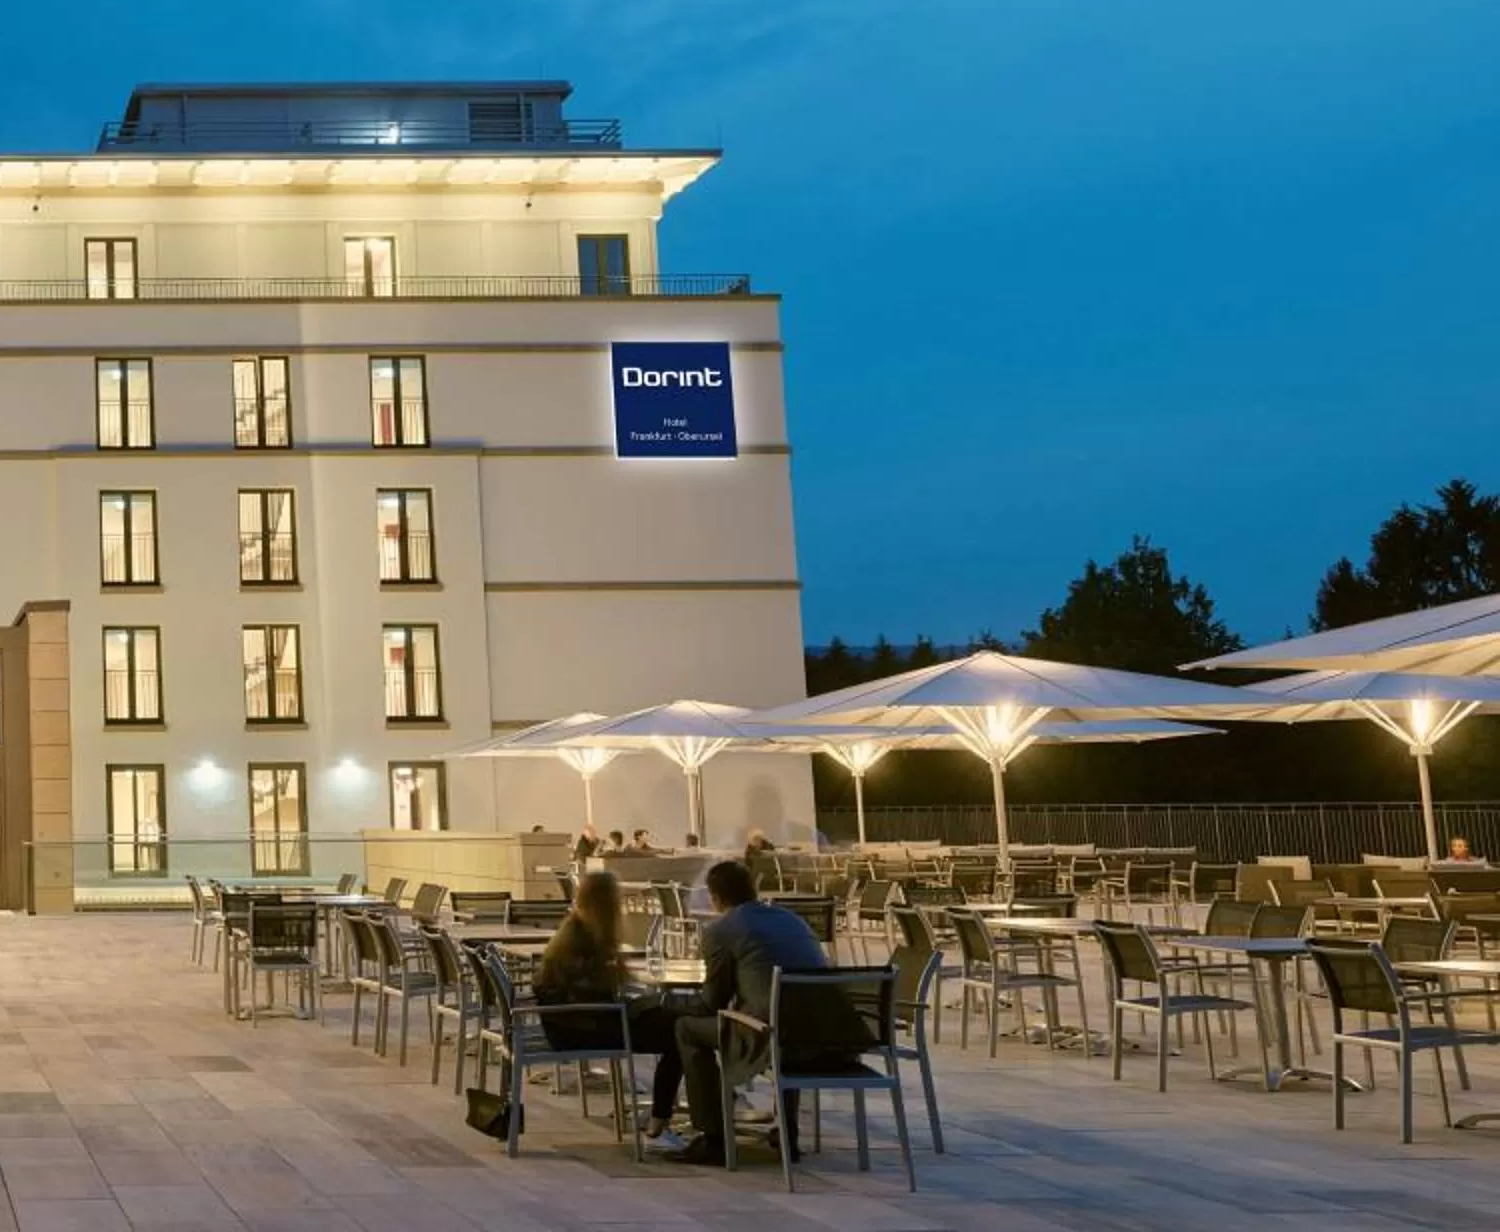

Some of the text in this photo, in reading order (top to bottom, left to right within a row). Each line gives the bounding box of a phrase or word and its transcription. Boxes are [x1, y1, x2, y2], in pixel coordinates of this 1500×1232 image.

[622, 367, 723, 387] Dorint
[663, 417, 688, 427] Hotel
[630, 431, 672, 441] Frankfurt
